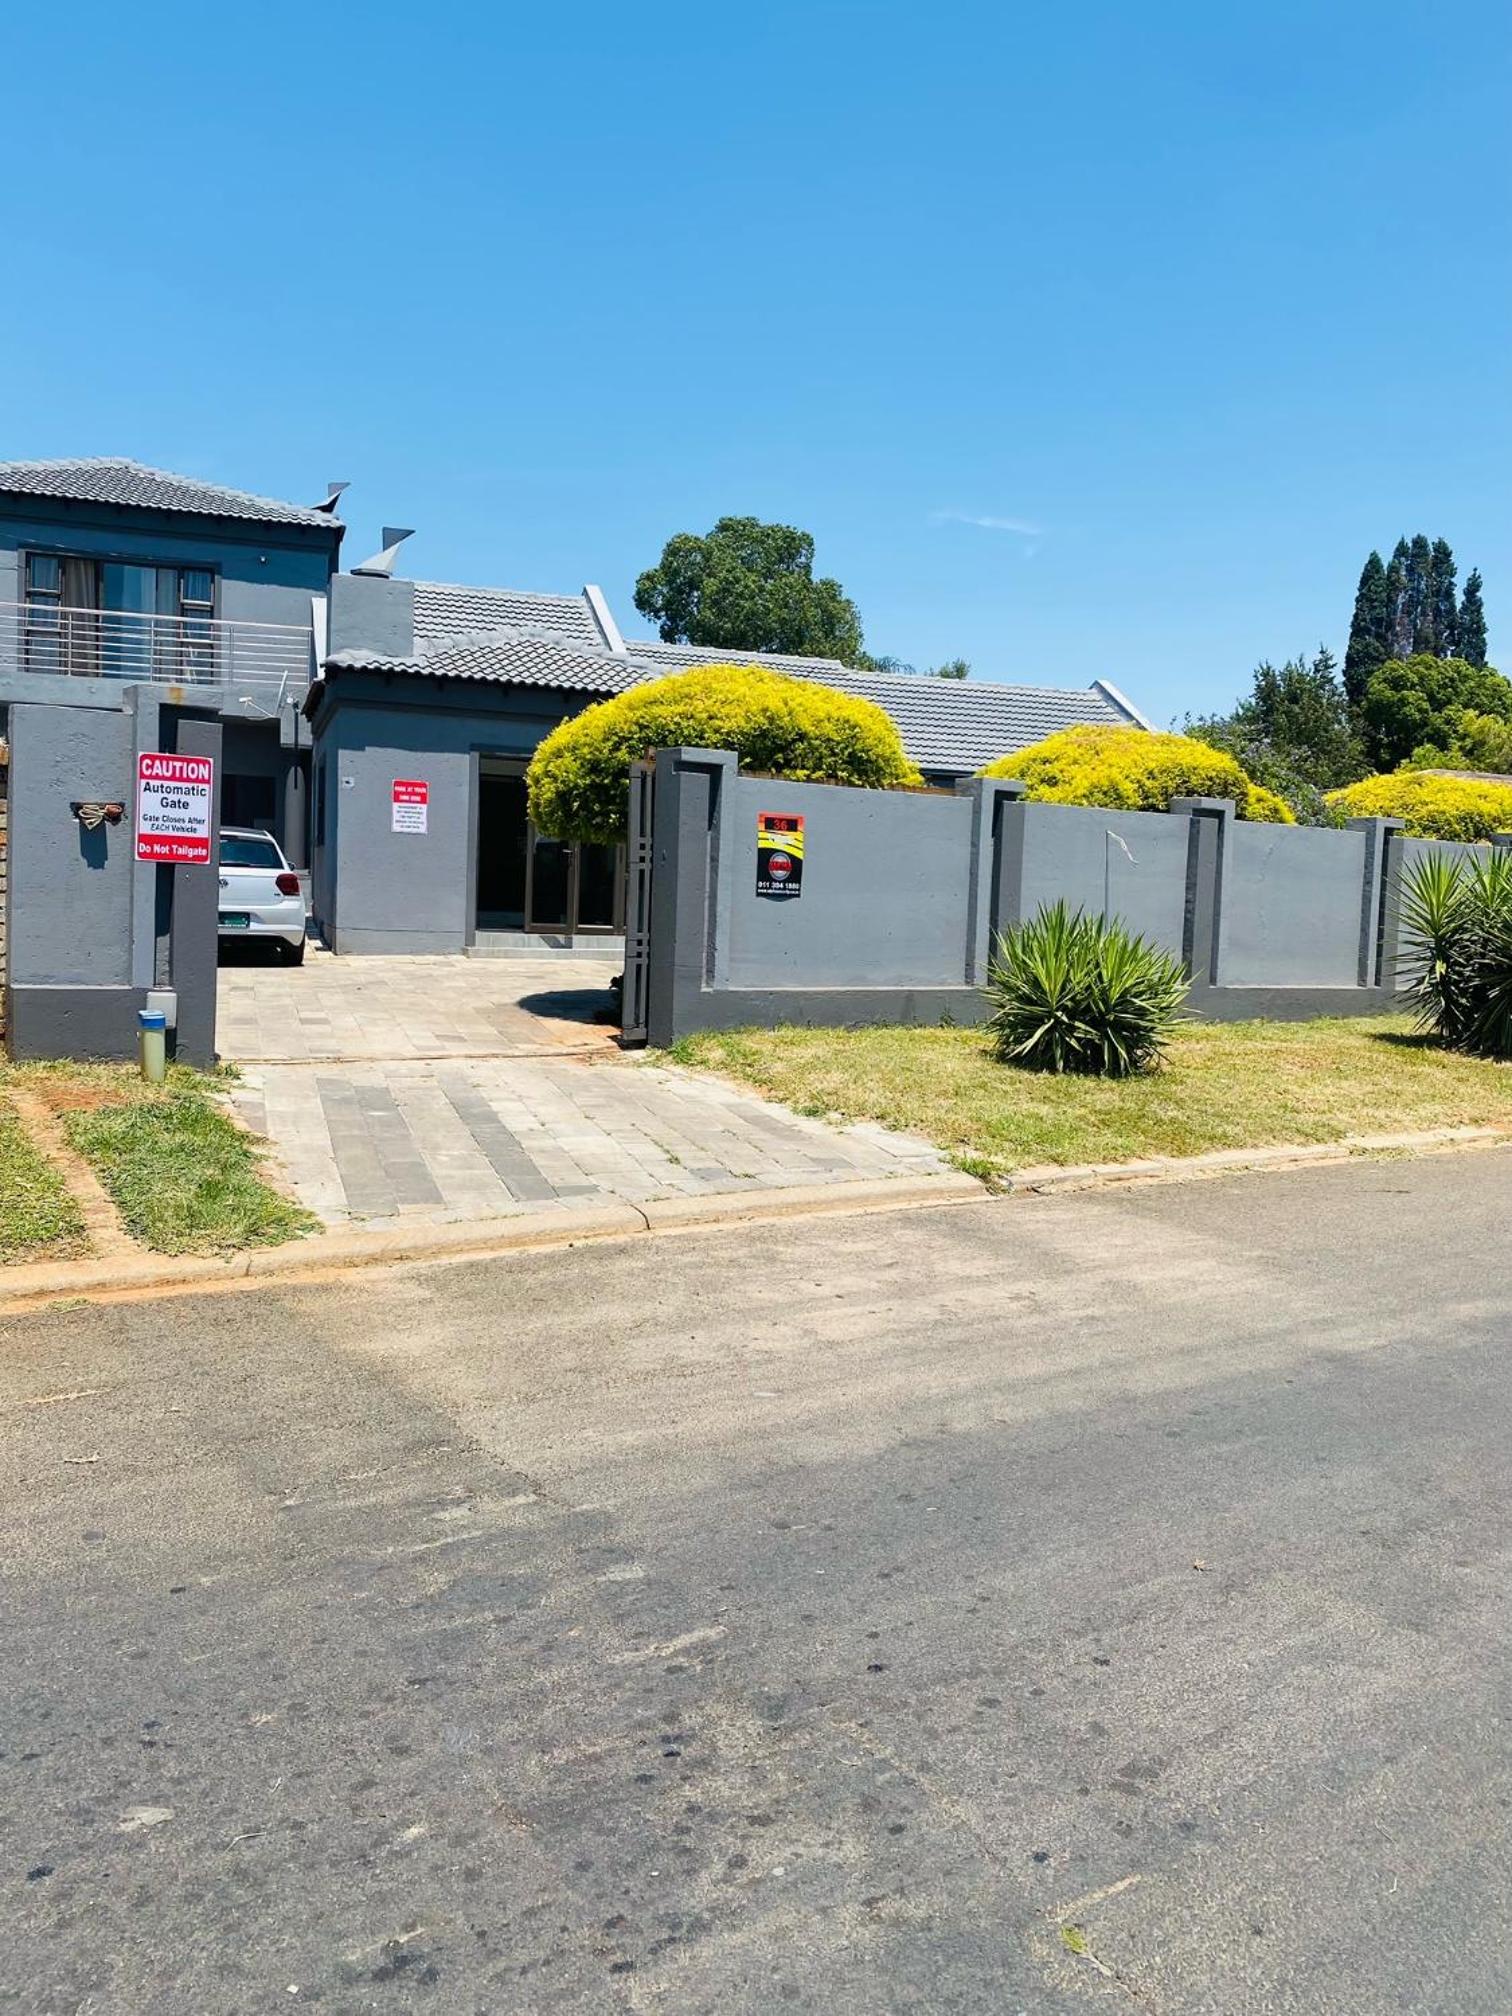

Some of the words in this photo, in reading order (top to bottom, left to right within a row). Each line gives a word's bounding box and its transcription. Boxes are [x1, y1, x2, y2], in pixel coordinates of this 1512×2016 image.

[142, 759, 209, 780] CAUTION
[143, 781, 207, 797] Automatic
[160, 797, 190, 810] Gate
[142, 813, 160, 822] Gate
[161, 815, 185, 824] Closes
[188, 816, 206, 825] After
[773, 819, 788, 831] 36
[150, 823, 171, 832] EACH
[171, 825, 198, 833] Vehicle
[139, 843, 151, 853] Do
[153, 844, 170, 854] Not
[172, 845, 208, 858] Tailgate
